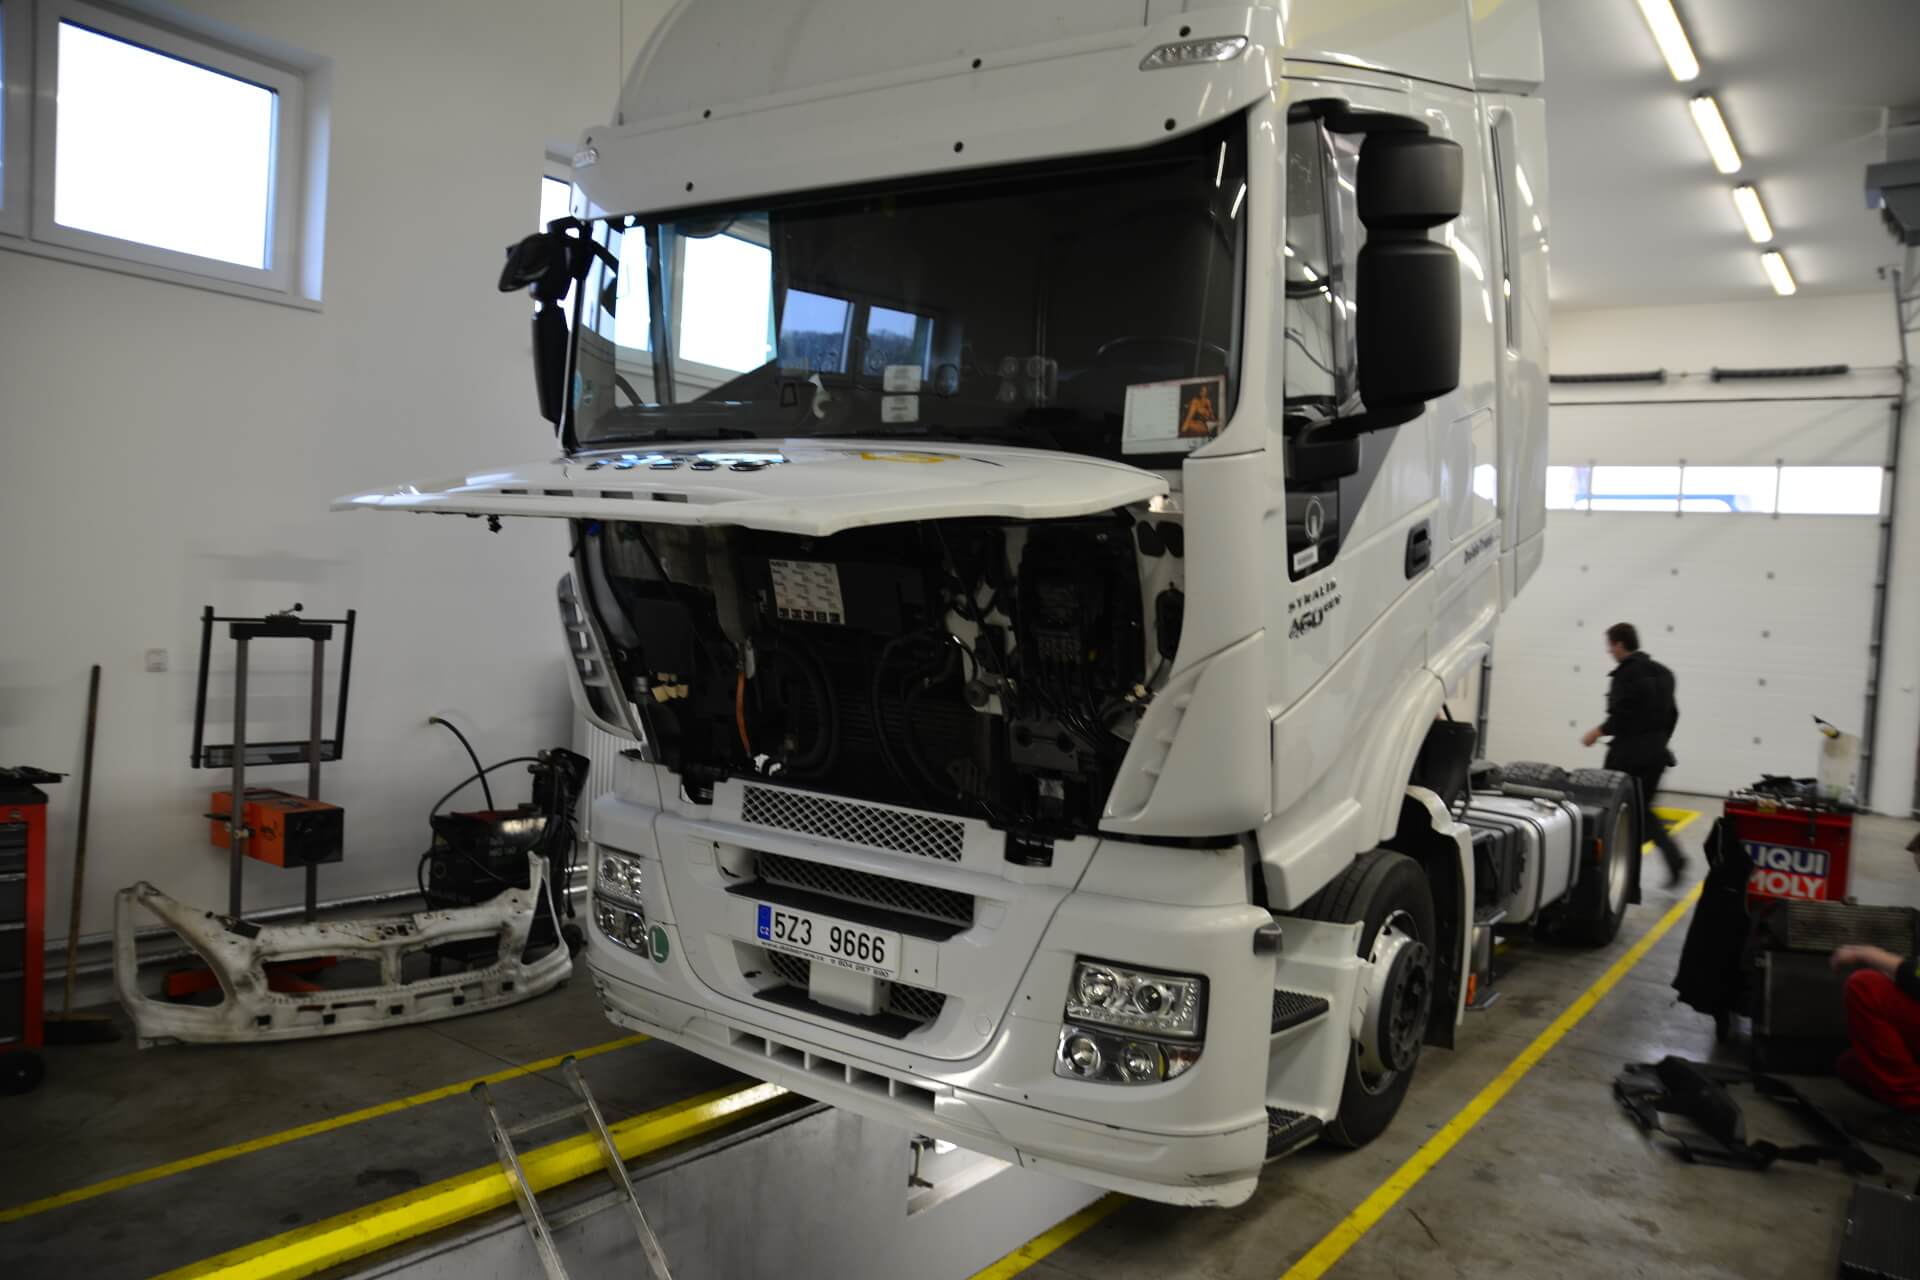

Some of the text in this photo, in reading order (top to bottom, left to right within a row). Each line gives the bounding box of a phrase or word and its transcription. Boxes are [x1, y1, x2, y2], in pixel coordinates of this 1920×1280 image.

[652, 931, 664, 958] L
[775, 912, 812, 945] 5Z3
[829, 926, 885, 963] 9666
